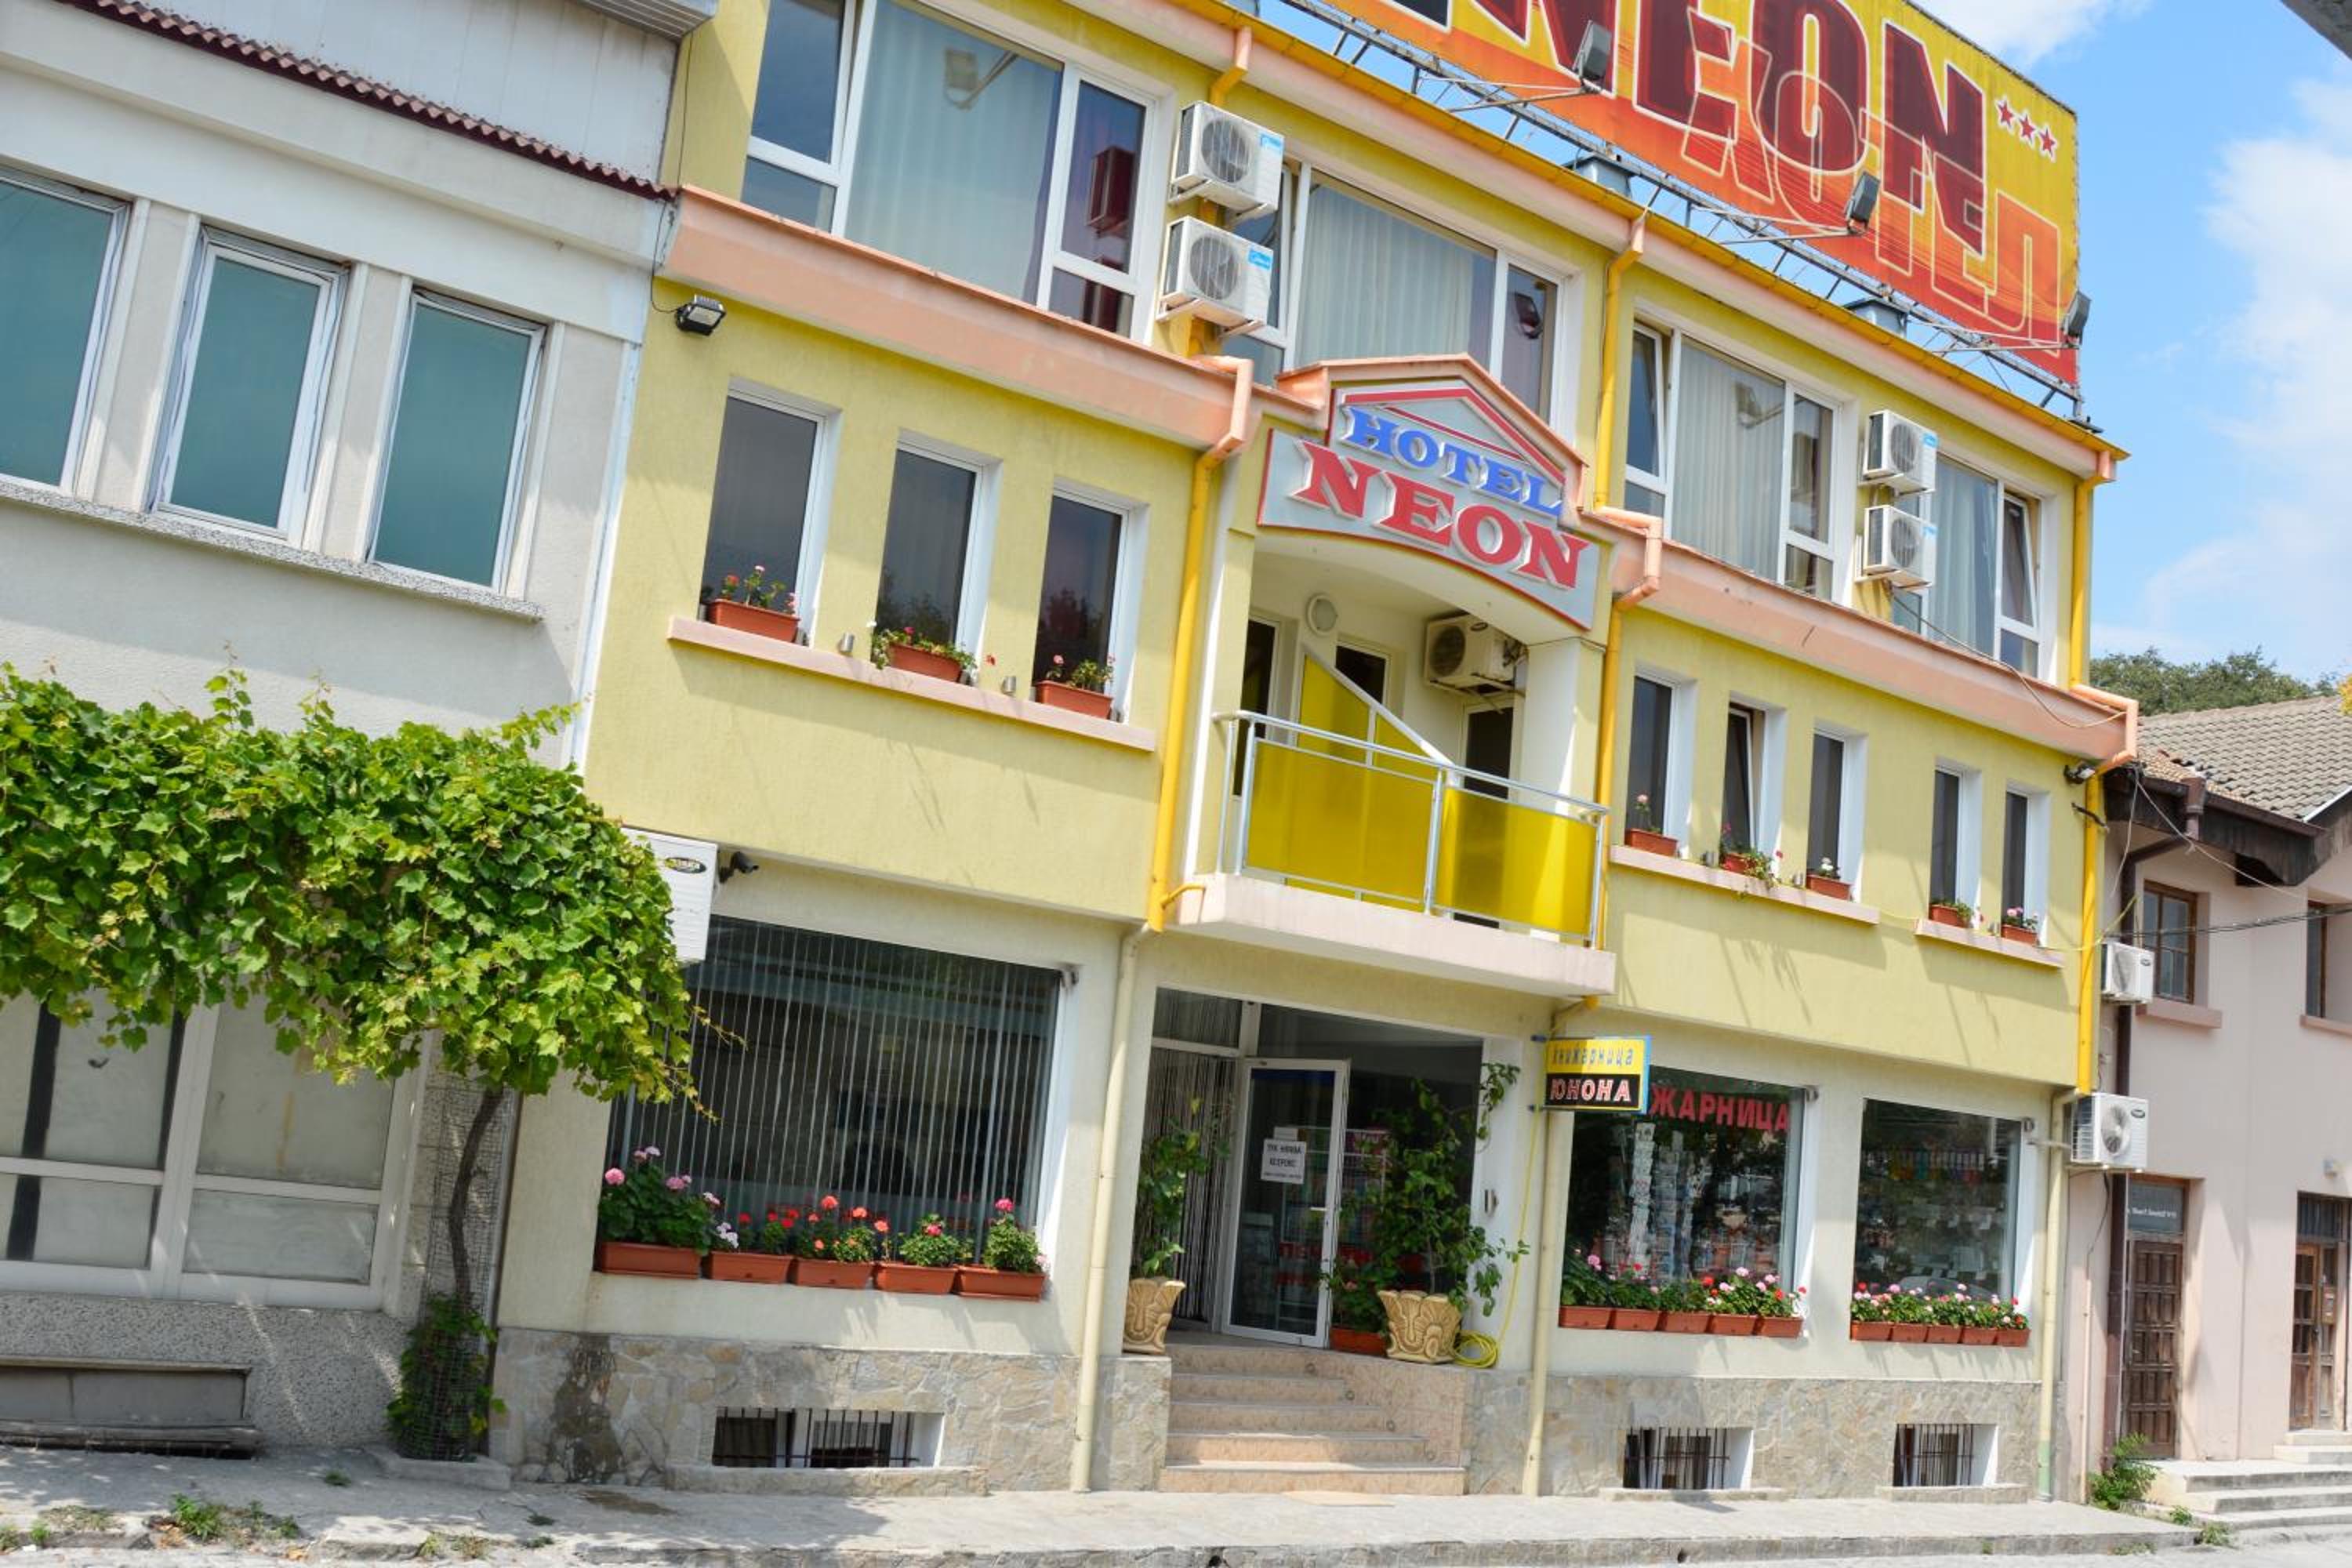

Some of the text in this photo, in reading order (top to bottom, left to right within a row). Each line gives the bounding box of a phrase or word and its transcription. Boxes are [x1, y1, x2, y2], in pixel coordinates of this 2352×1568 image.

[1292, 441, 1592, 590] NEON
[1344, 405, 1563, 519] HOTEL
[1549, 1078, 1632, 1102] ЮНОНА
